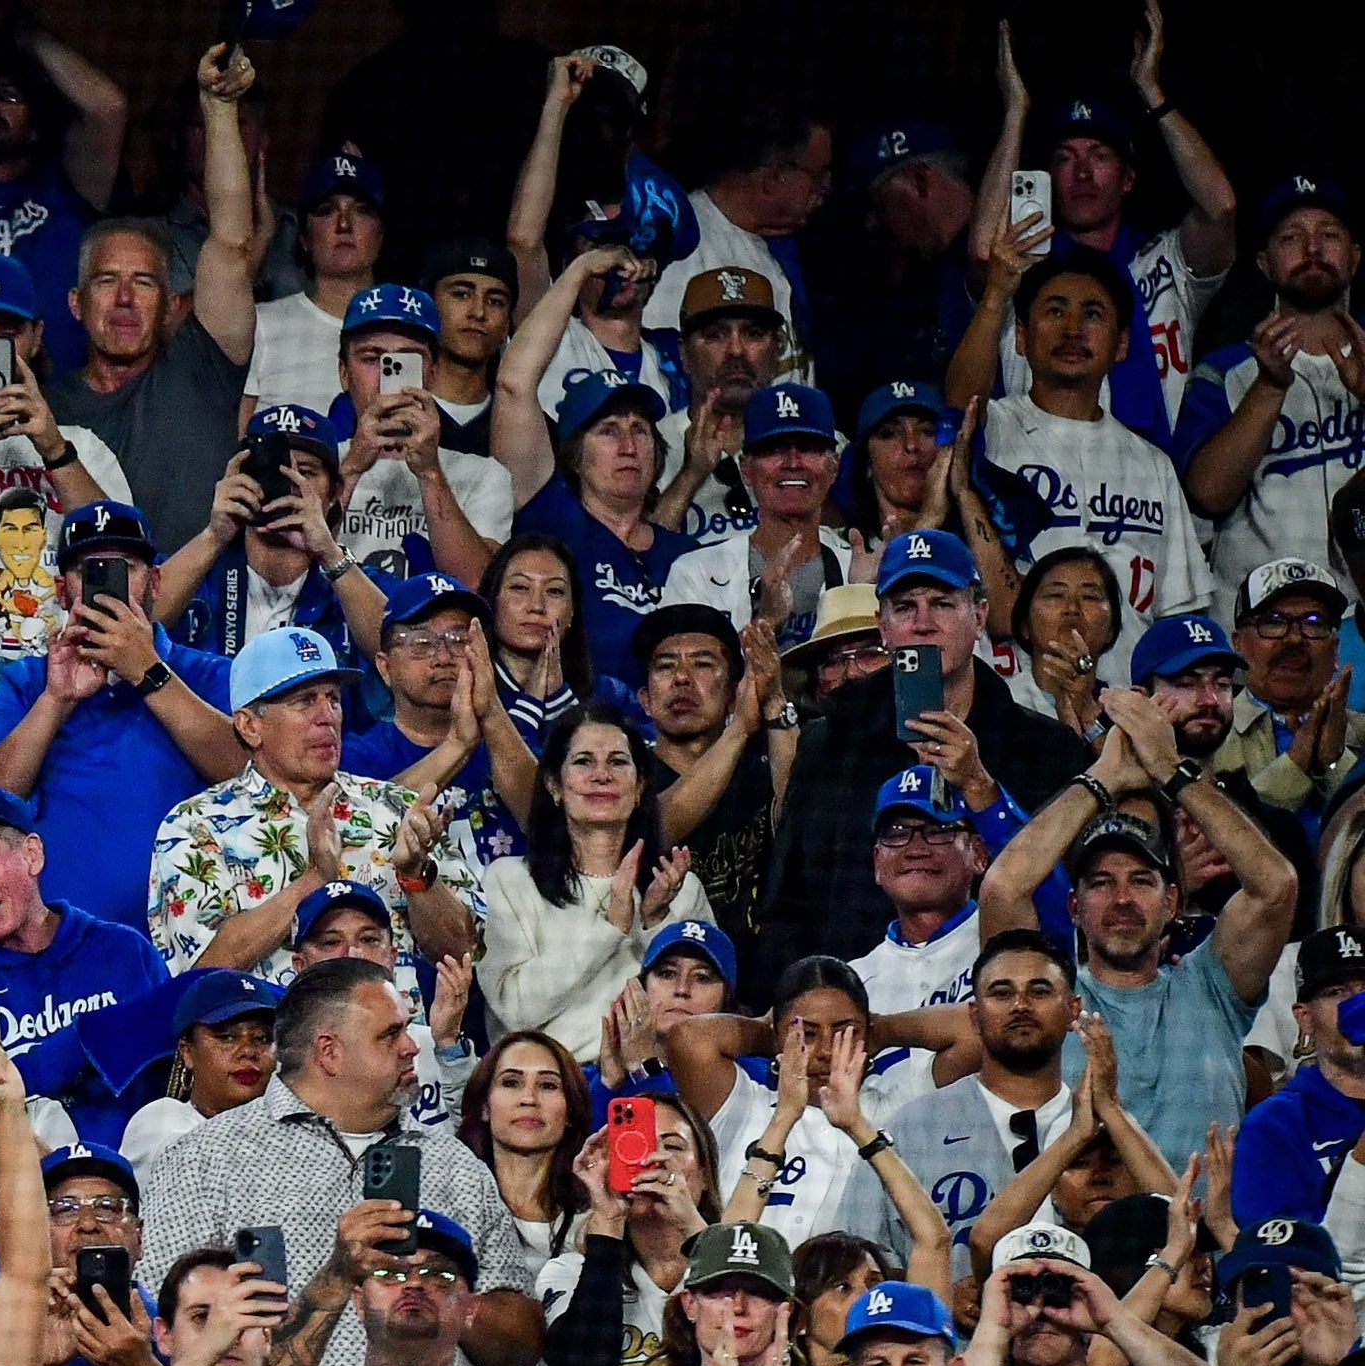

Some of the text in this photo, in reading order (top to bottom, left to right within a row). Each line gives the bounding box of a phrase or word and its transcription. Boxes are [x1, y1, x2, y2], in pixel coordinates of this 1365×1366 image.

[334, 156, 356, 176] LA
[1293, 175, 1314, 192] LA
[892, 381, 914, 398] LA
[776, 391, 798, 418] LA
[273, 406, 299, 431] LA
[1270, 402, 1365, 473] Dodg
[365, 496, 412, 519] team
[1018, 463, 1164, 541] Dodgers
[906, 534, 931, 559] LA
[429, 575, 455, 595] LA
[225, 568, 239, 656] TOKYO SERIES
[1183, 620, 1213, 643] LA
[291, 633, 320, 662] LA
[899, 770, 921, 792] LA
[327, 880, 351, 898] LA
[682, 921, 707, 941] LA
[1337, 931, 1363, 958] LA
[731, 1227, 759, 1259] LA
[868, 1290, 892, 1315] LA
